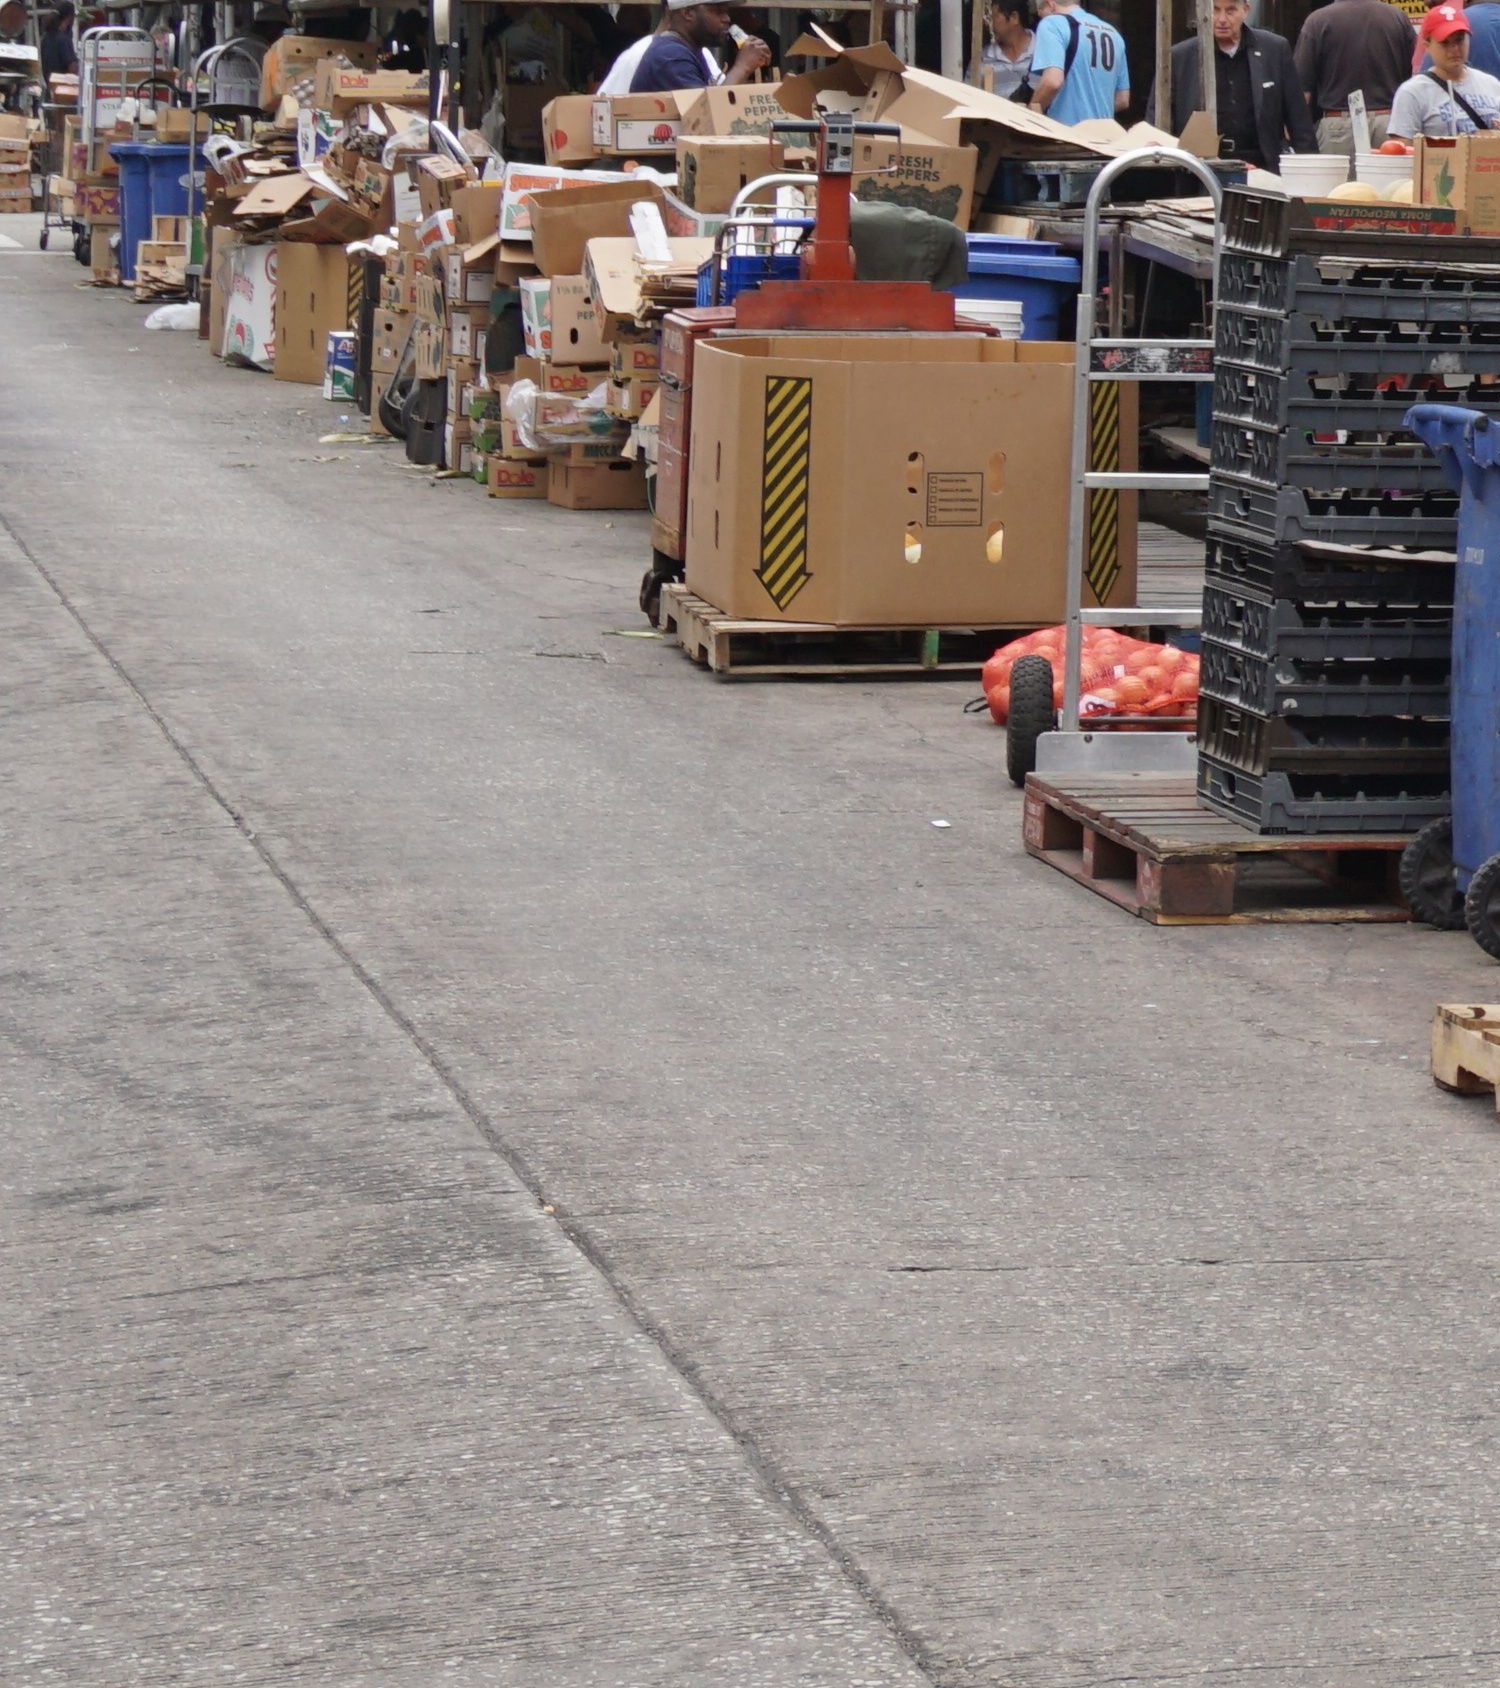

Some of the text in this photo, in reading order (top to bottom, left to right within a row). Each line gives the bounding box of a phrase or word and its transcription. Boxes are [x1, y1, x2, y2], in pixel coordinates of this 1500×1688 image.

[1086, 30, 1115, 72] 10
[340, 75, 369, 88] Dole
[744, 106, 785, 117] PEPPE
[887, 153, 934, 169] FRESH
[878, 165, 941, 183] PEPPERS
[1329, 207, 1432, 220] ROMA NEOPOLITAN
[633, 350, 660, 368] Do
[551, 375, 588, 391] Dole
[497, 469, 536, 486] Dole
